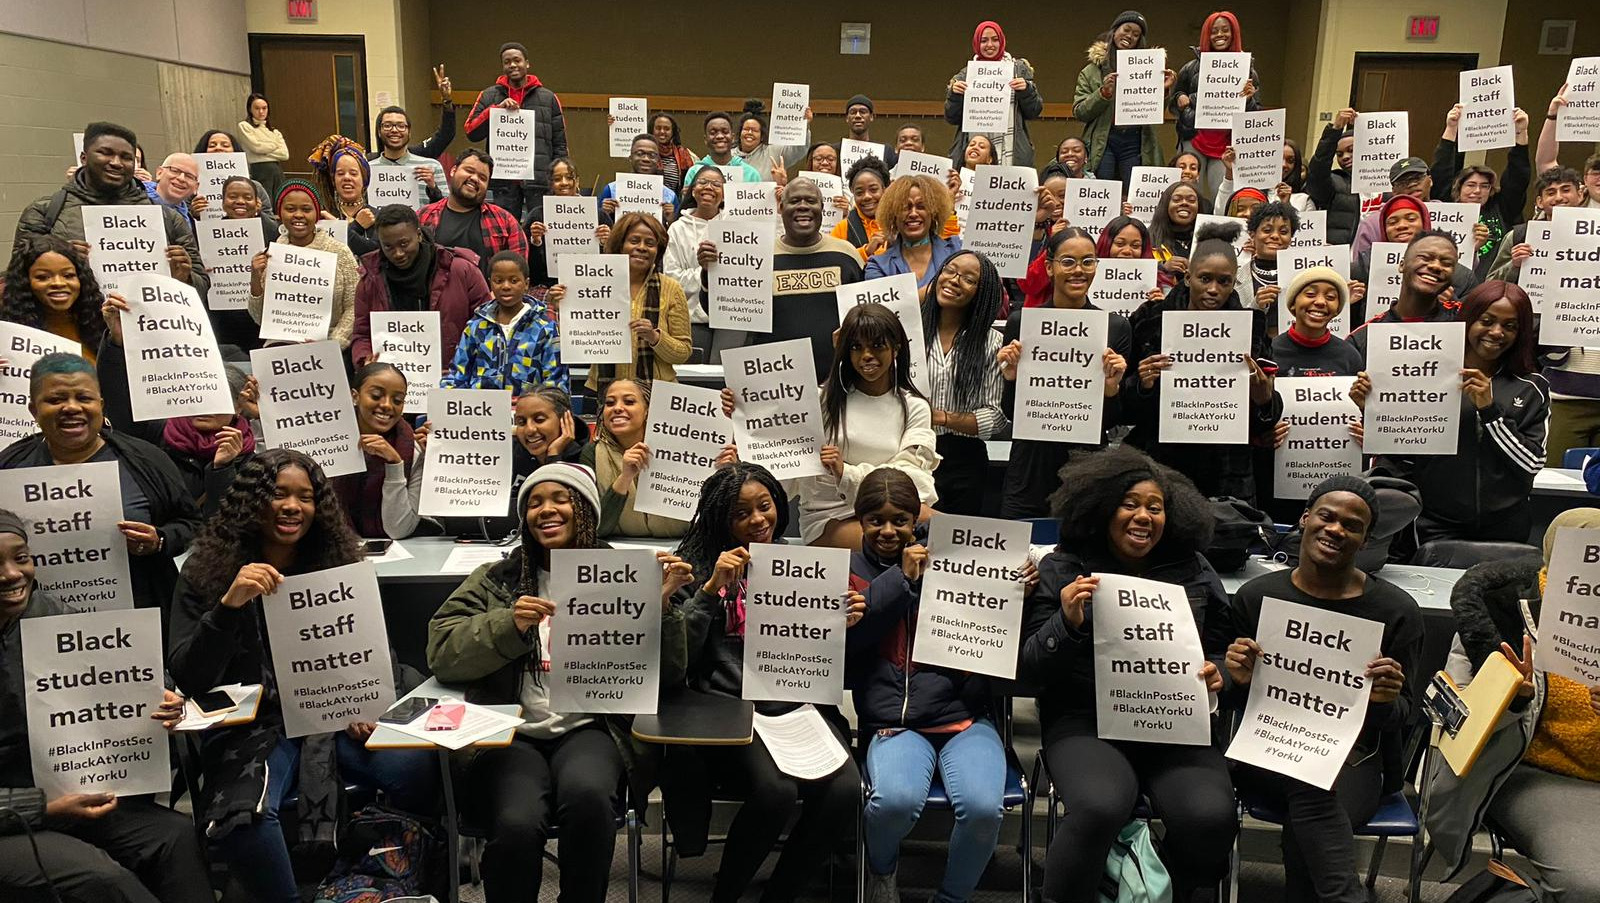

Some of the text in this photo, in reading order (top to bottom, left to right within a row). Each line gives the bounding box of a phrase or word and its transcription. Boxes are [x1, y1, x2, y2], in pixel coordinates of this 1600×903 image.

[1128, 56, 1154, 65] Black
[1212, 60, 1238, 68] Black
[1130, 70, 1152, 80] staff
[1576, 66, 1598, 75] Black
[973, 81, 1005, 91] faculty
[1206, 74, 1241, 86] faculty
[1472, 75, 1501, 86] Black
[1572, 82, 1596, 92] staff
[1204, 90, 1239, 99] matter
[1473, 90, 1500, 102] staff
[778, 101, 804, 112] faculty
[1566, 100, 1600, 108] matter
[500, 115, 524, 124] Black
[1467, 108, 1507, 119] matter
[1245, 118, 1273, 128] Black
[1368, 119, 1396, 129] Black
[496, 128, 528, 140] faculty
[1236, 134, 1280, 144] students
[1368, 134, 1395, 145] staff
[497, 144, 528, 152] matter
[1239, 150, 1276, 159] matter
[1361, 152, 1400, 161] matter
[206, 160, 236, 170] Black
[910, 161, 940, 175] Black
[378, 173, 406, 182] Black
[990, 176, 1026, 190] Black
[1142, 174, 1168, 183] Black
[627, 180, 652, 190] Black
[376, 188, 411, 199] faculty
[620, 195, 659, 204] students
[737, 190, 765, 200] Black
[1079, 188, 1110, 199] Black
[556, 204, 585, 214] Black
[729, 206, 773, 216] students
[975, 198, 1032, 211] students
[1079, 206, 1107, 217] staff
[103, 215, 146, 228] Black
[548, 220, 594, 229] students
[976, 221, 1024, 232] matter
[212, 227, 248, 238] Black
[723, 231, 758, 244] Black
[99, 237, 155, 252] faculty
[553, 237, 591, 245] matter
[218, 245, 248, 256] staff
[102, 261, 158, 272] matter
[284, 254, 320, 268] Black
[718, 254, 763, 270] faculty
[1294, 256, 1333, 270] Black
[213, 264, 251, 274] matte
[575, 264, 613, 277] Black
[1105, 268, 1142, 280] Black
[272, 272, 329, 286] students
[718, 276, 763, 288] matter
[142, 286, 190, 306] Black
[275, 292, 323, 304] matter
[578, 286, 612, 298] staff
[856, 288, 900, 304] Black
[571, 309, 620, 319] matter
[137, 315, 201, 336] faculty
[388, 321, 424, 332] Black
[1041, 321, 1088, 337] Black
[1183, 323, 1230, 338] Black
[382, 340, 430, 356] faculty
[1390, 335, 1442, 350] Black
[142, 344, 208, 360] matter
[1032, 346, 1094, 367] faculty
[1168, 350, 1244, 363] students
[272, 355, 323, 375] Black
[744, 354, 794, 375] Black
[1392, 361, 1438, 376] staff
[142, 372, 217, 382] #BlackInPostSec
[1030, 376, 1092, 389] matter
[1174, 376, 1236, 388] matter
[146, 384, 217, 394] #BlackAtYorkU
[270, 382, 335, 402] faculty
[741, 383, 804, 402] faculty
[1296, 388, 1342, 402] Black
[167, 396, 202, 405] #YorkU
[1380, 390, 1448, 402] matter
[447, 401, 492, 416] Black
[670, 396, 717, 417] Black
[276, 410, 341, 429] matter
[746, 412, 808, 430] matter
[1282, 412, 1356, 426] students
[434, 426, 506, 441] students
[653, 422, 726, 444] students
[1288, 438, 1350, 449] matter
[439, 453, 500, 466] matter
[656, 449, 716, 468] matter
[24, 479, 93, 502] Black
[34, 511, 92, 534] staff
[952, 529, 1006, 550] Black
[578, 564, 638, 583] Black
[772, 559, 826, 579] Black
[932, 558, 1018, 581] students
[289, 582, 354, 610] Black
[754, 591, 840, 610] students
[936, 590, 1008, 610] matter
[1118, 590, 1171, 611] Black
[567, 597, 646, 620] faculty
[299, 614, 354, 641] staff
[760, 623, 831, 640] matter
[931, 615, 1007, 637] #BlackInPostSec
[1123, 623, 1174, 641] staff
[57, 627, 132, 653] Black
[568, 630, 646, 645] matter
[932, 625, 1003, 648] #BlackAtYorkU
[1286, 620, 1352, 652] Black
[756, 651, 832, 664] #BlackInPostSec
[948, 646, 983, 658] #YorkU
[292, 650, 372, 673] matter
[564, 661, 647, 670] #BlackInPostSec
[1112, 658, 1190, 674] matter
[758, 664, 829, 677] #BlackAtYorkU
[1263, 650, 1364, 689] students
[36, 666, 154, 692] students
[566, 675, 643, 685] #BlackAtYorkU
[776, 679, 810, 688] #YorkU
[294, 679, 380, 700] #BlackInPostSec
[586, 690, 623, 699] #YorkU
[1110, 689, 1195, 701] #BlackInPostSec
[300, 687, 378, 709] #BlackAtYorkU
[1267, 684, 1348, 722] matter
[50, 702, 146, 727] matter
[322, 708, 360, 720] #YorkU
[1113, 704, 1192, 716] #BlackAtYorkU
[1134, 720, 1172, 730] #YorkU
[1257, 712, 1339, 746] #BlackInPostSec
[49, 736, 153, 756] #BlackInPostSec
[53, 750, 150, 772] #BlackAtYorkU
[80, 769, 128, 785] #YorkU
